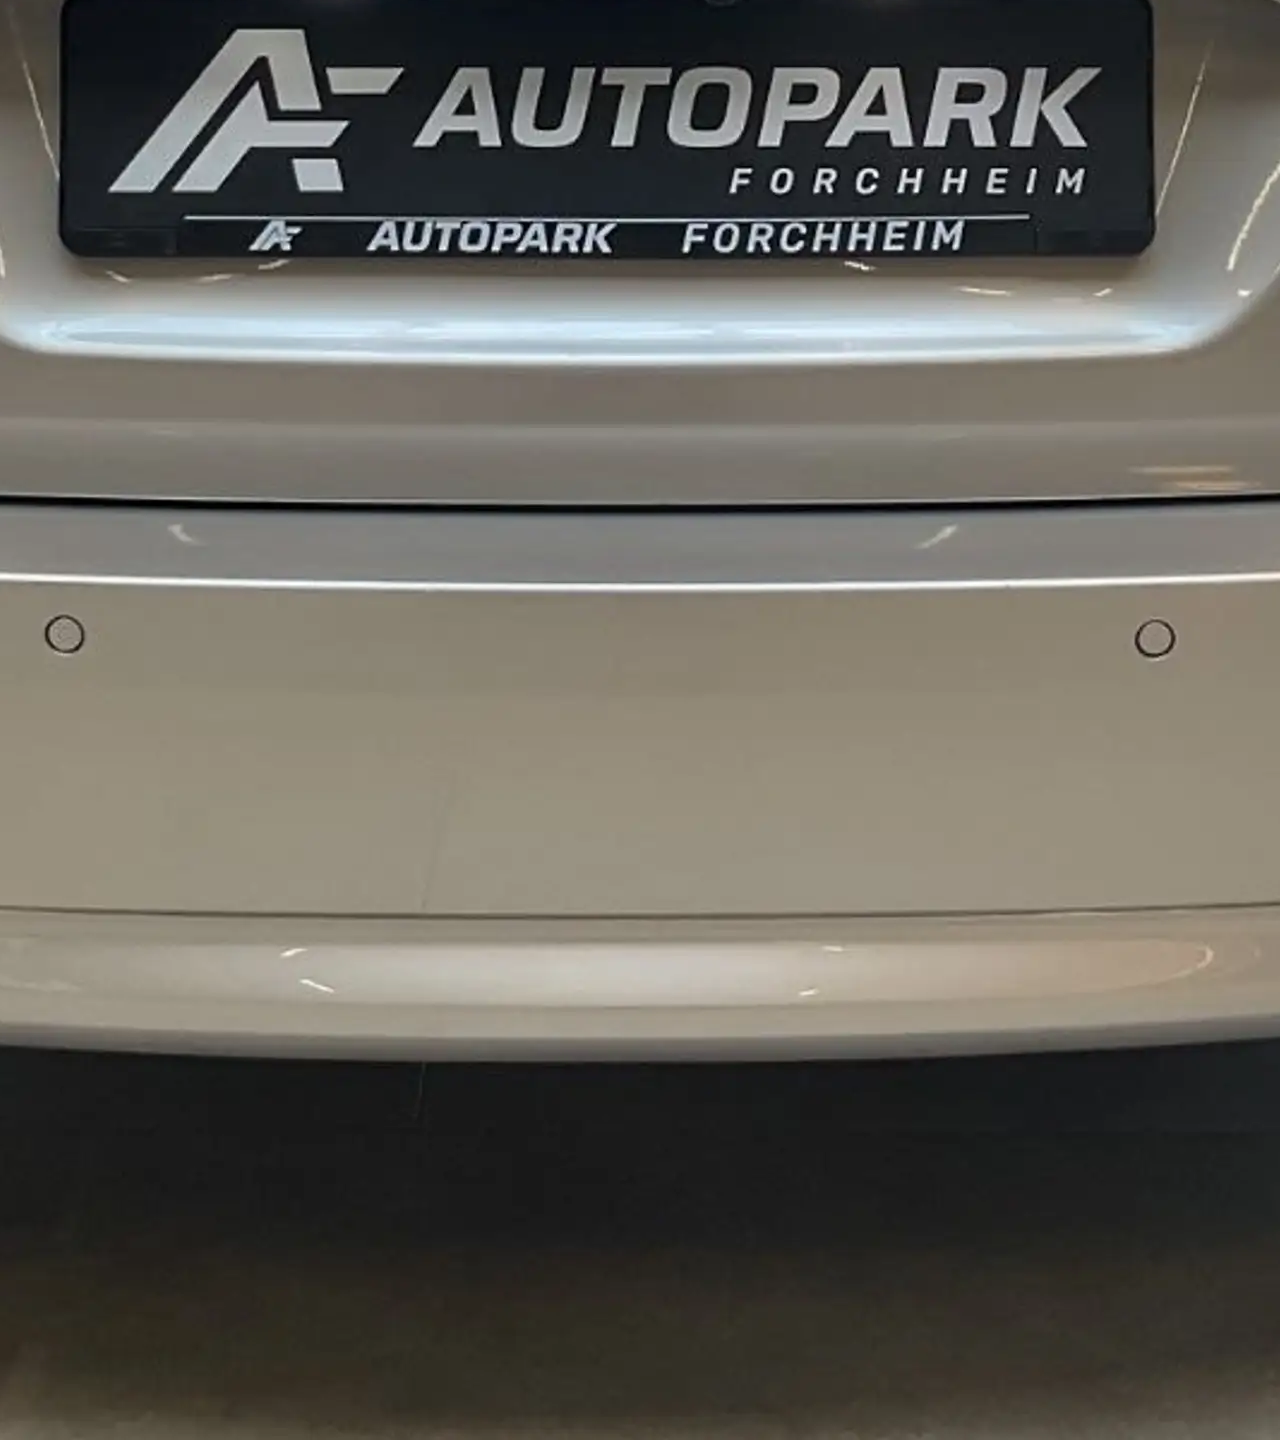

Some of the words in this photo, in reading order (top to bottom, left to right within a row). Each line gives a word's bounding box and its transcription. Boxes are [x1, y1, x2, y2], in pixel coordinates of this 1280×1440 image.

[412, 67, 1101, 148] AUTOPARK
[728, 167, 1086, 195] FORCHHEIM
[366, 221, 616, 254] AUTOPARK
[681, 219, 964, 254] FORCHHEIM
